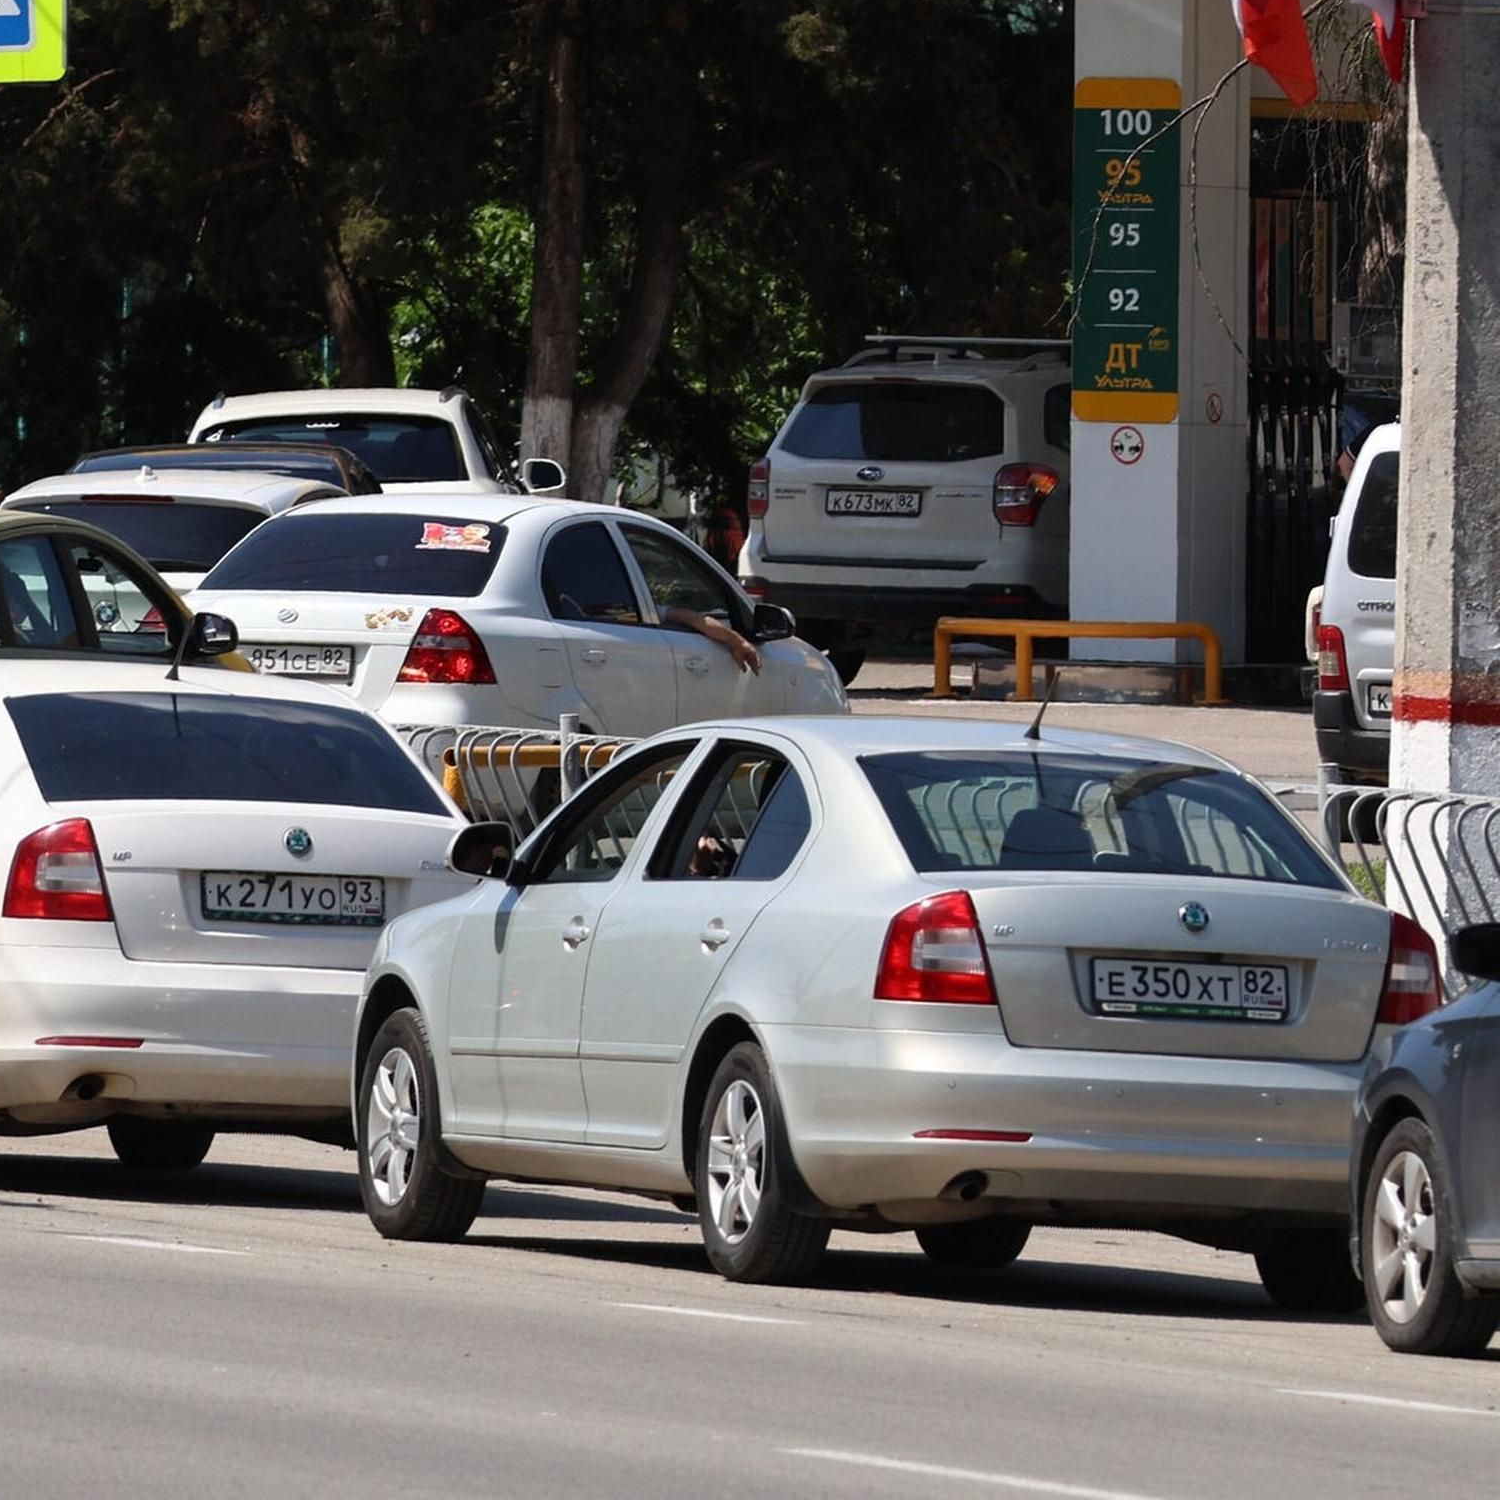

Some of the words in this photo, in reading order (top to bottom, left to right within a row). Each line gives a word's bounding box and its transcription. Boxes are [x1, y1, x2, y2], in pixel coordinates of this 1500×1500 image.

[1100, 109, 1152, 136] 100
[1105, 158, 1143, 187] 95
[1109, 223, 1141, 246] 95
[1108, 288, 1140, 311] 92
[1105, 343, 1143, 374] ДТ
[323, 649, 344, 666] 82
[216, 876, 336, 911] К271УО
[344, 881, 373, 903] 93
[1108, 965, 1234, 1002] Е350ХТ
[1244, 970, 1275, 995] 82
